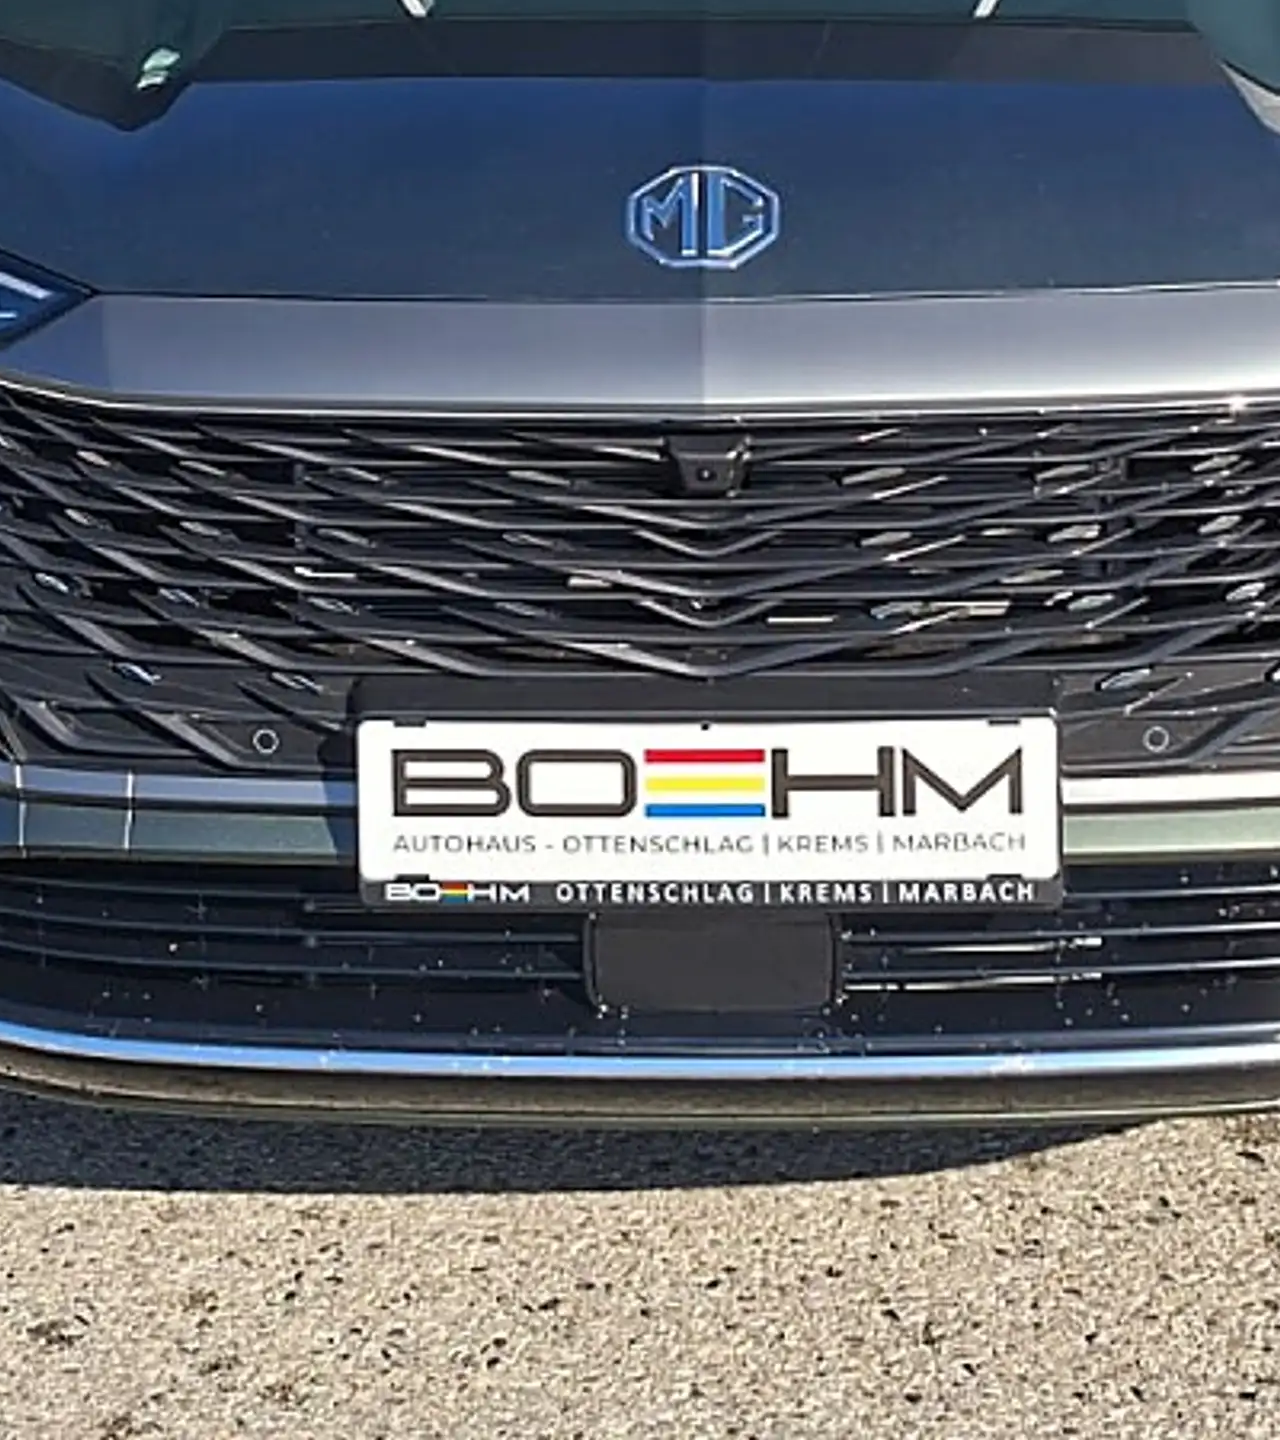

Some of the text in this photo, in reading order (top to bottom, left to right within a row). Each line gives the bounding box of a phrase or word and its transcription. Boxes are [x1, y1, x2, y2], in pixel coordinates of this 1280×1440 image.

[641, 172, 764, 258] MG
[391, 746, 1023, 819] BOEHM
[393, 835, 536, 853] AUTOHAUS
[563, 834, 754, 854] OTTENSCHLAG
[777, 834, 869, 853] KREMS
[892, 832, 1026, 853] MARBACH
[556, 883, 753, 903] OTTENSCHLAG
[780, 883, 872, 902] KREMS
[899, 883, 1034, 902] MARBACH
